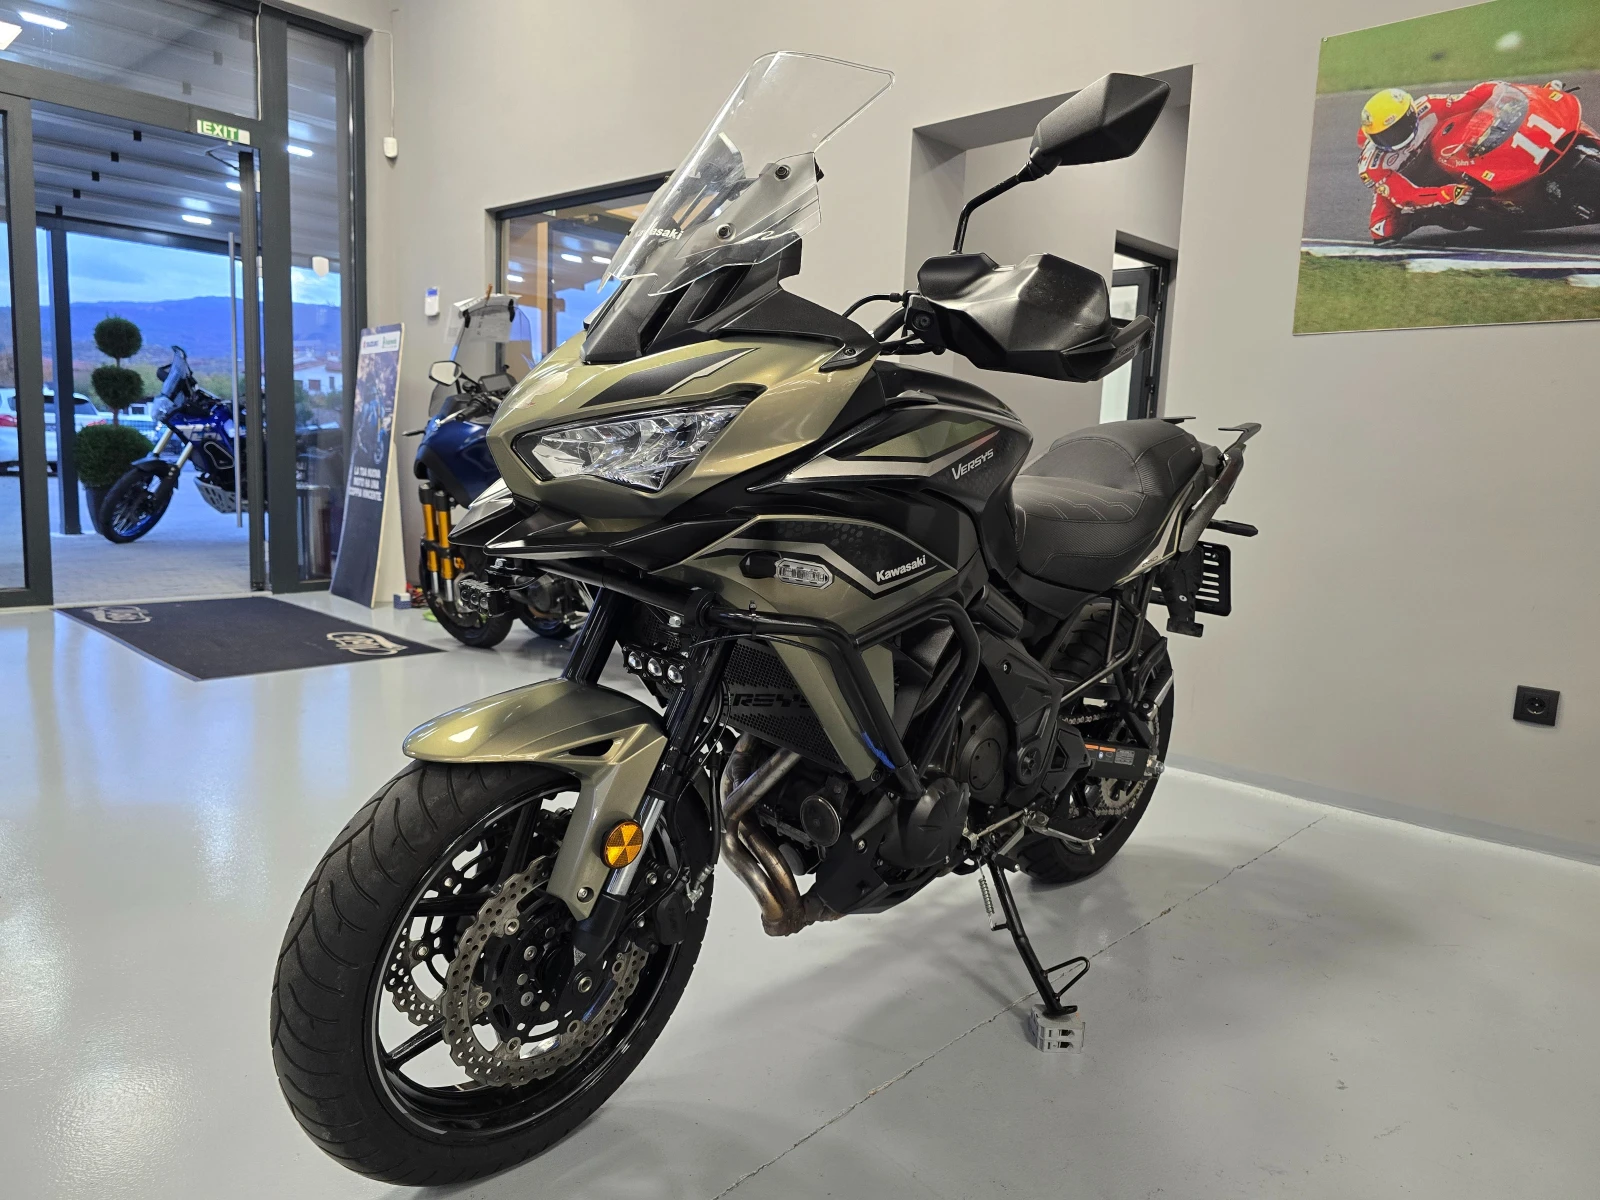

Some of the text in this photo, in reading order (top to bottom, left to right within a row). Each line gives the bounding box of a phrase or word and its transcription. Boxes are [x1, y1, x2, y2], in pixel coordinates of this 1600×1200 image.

[202, 121, 237, 140] EXIT
[1511, 114, 1566, 165] 11
[952, 449, 994, 480] VERSYS
[876, 555, 926, 582] Kawasaki
